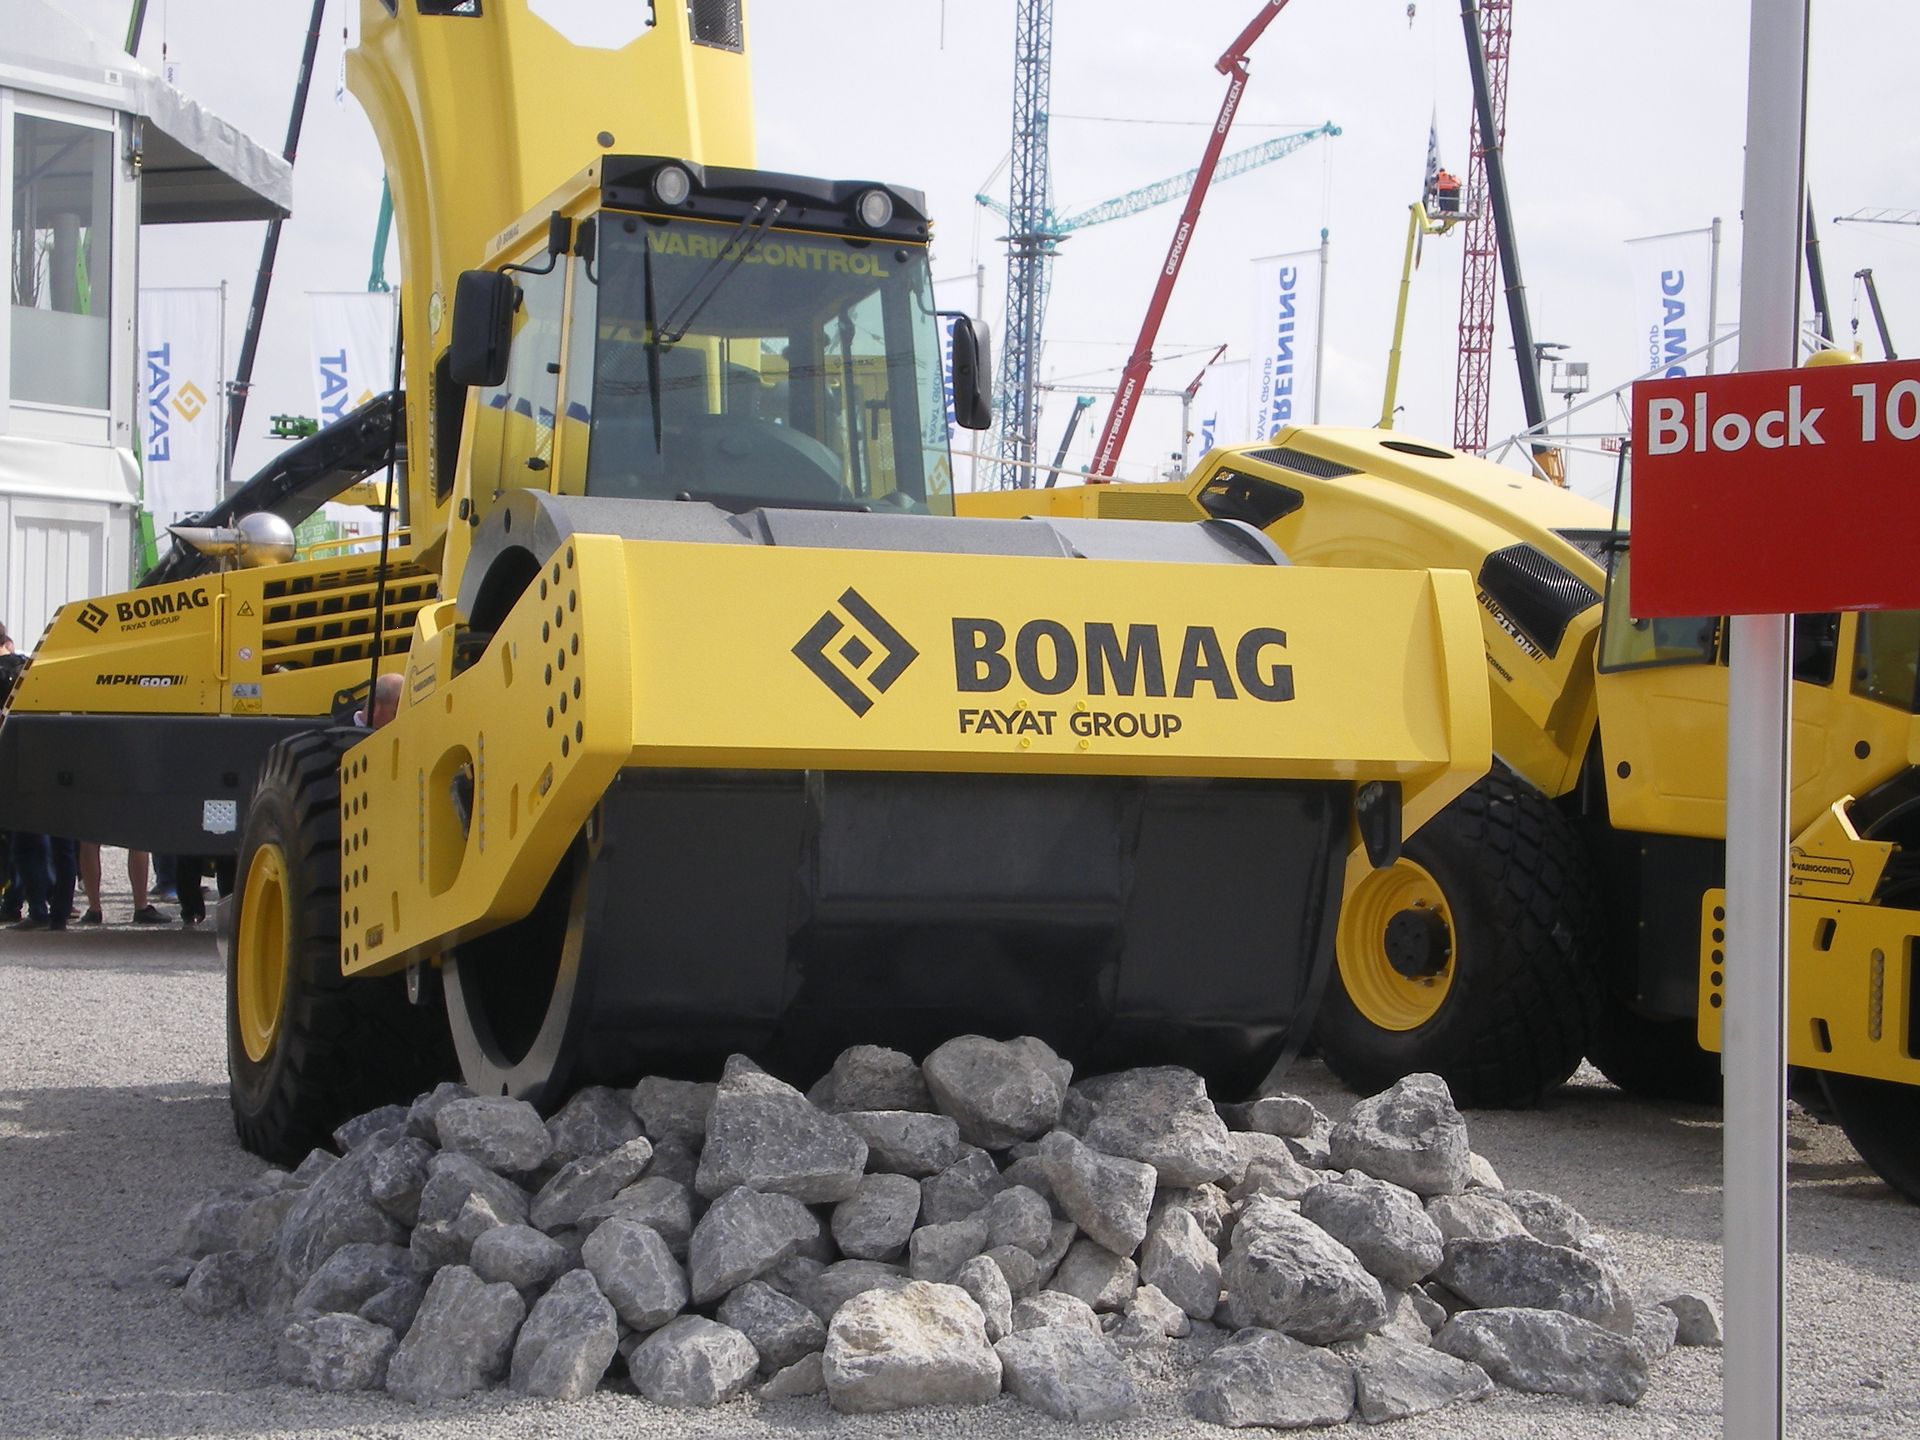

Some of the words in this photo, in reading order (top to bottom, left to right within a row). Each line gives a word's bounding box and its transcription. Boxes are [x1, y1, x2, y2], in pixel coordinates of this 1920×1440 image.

[1217, 80, 1242, 133] GERKEN
[647, 230, 890, 277] VARIOCONTROL
[1165, 222, 1191, 275] GERKEN
[1095, 378, 1136, 477] ARBEITSBÜHNEN
[1648, 385, 1826, 456] Block
[116, 588, 209, 622] BOMAG
[121, 621, 147, 632] FAYAT
[149, 615, 180, 627] GROUP
[951, 616, 1296, 703] BOMAG
[958, 708, 1057, 736] FAYAT
[1069, 711, 1183, 739] GROUP
